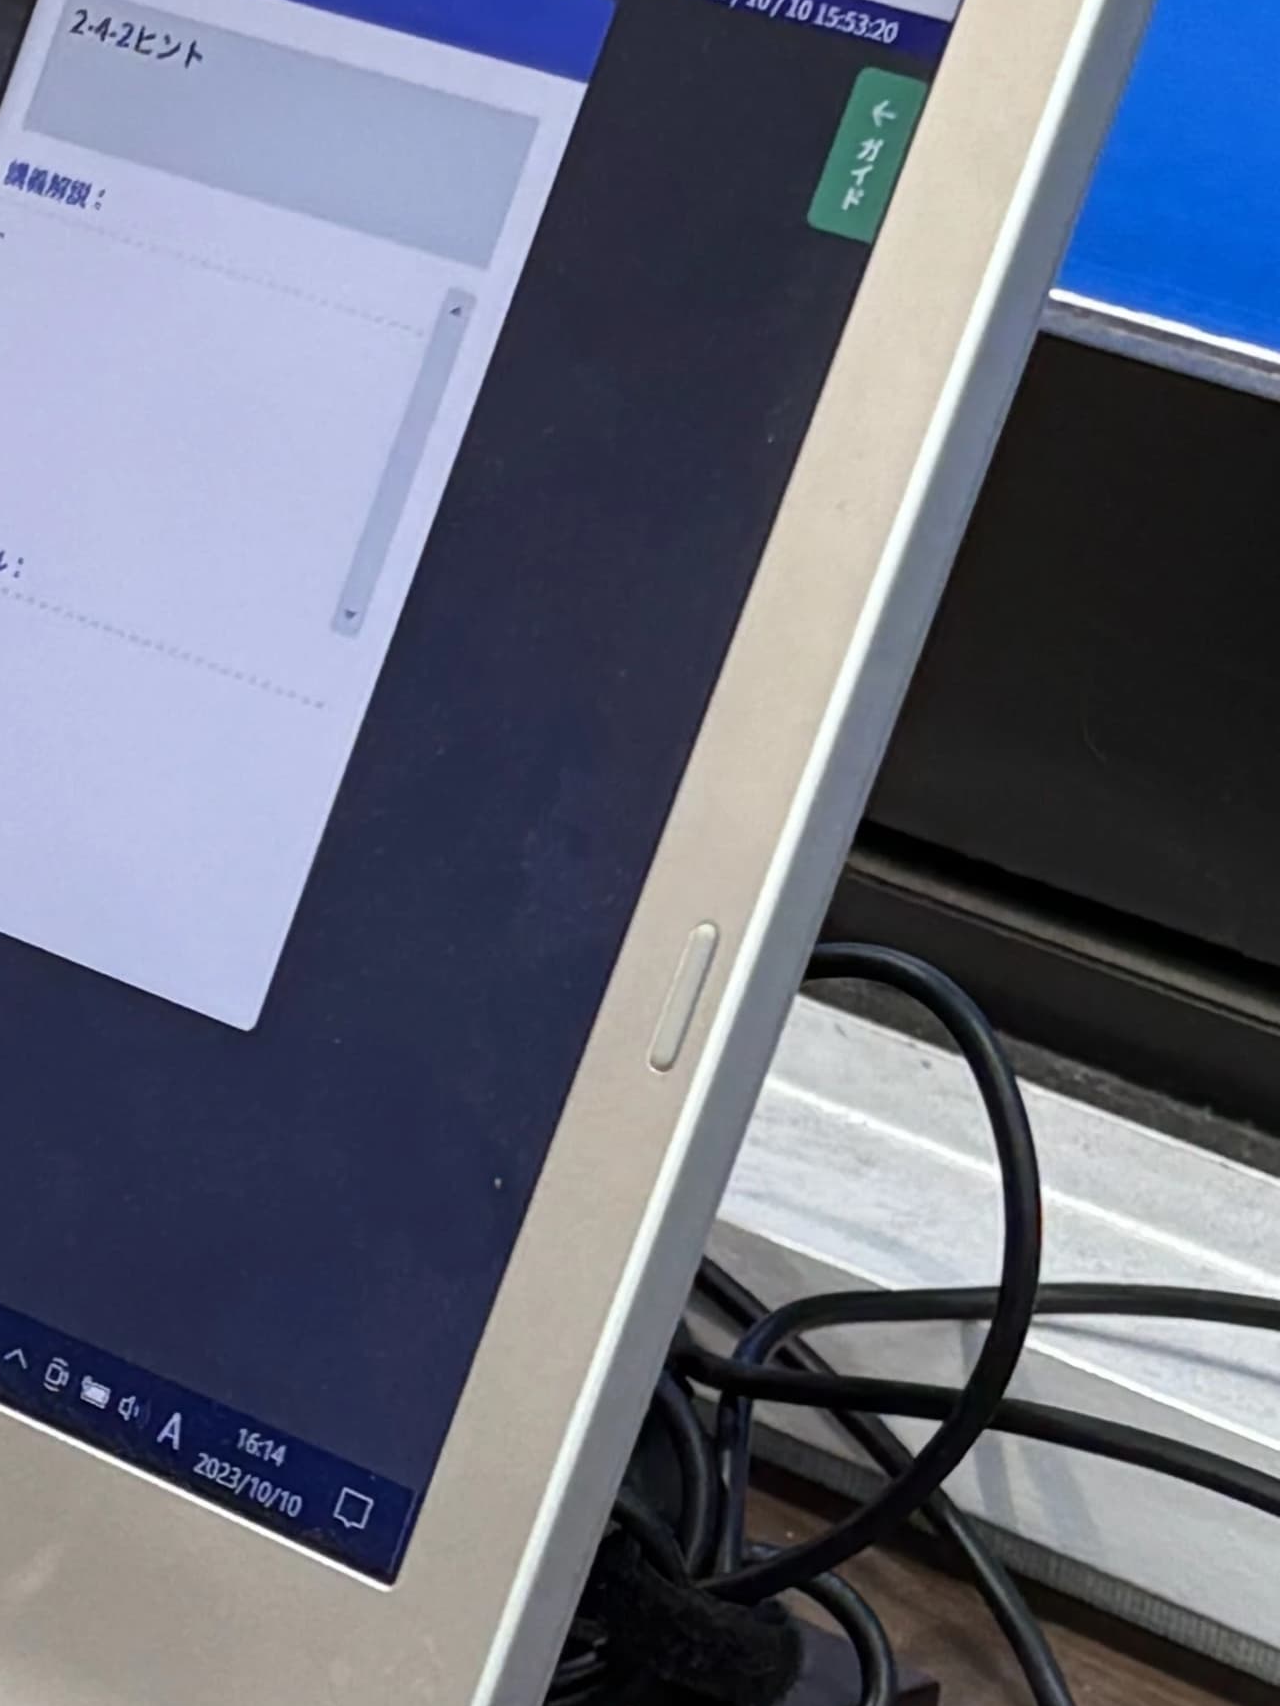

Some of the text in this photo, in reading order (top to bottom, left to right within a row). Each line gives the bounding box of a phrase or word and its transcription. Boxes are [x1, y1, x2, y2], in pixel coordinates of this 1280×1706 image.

[841, 138, 885, 212] ガイド
[157, 1412, 182, 1451] A
[236, 1427, 287, 1467] 16:14
[194, 1452, 303, 1519] 2023/10/10
